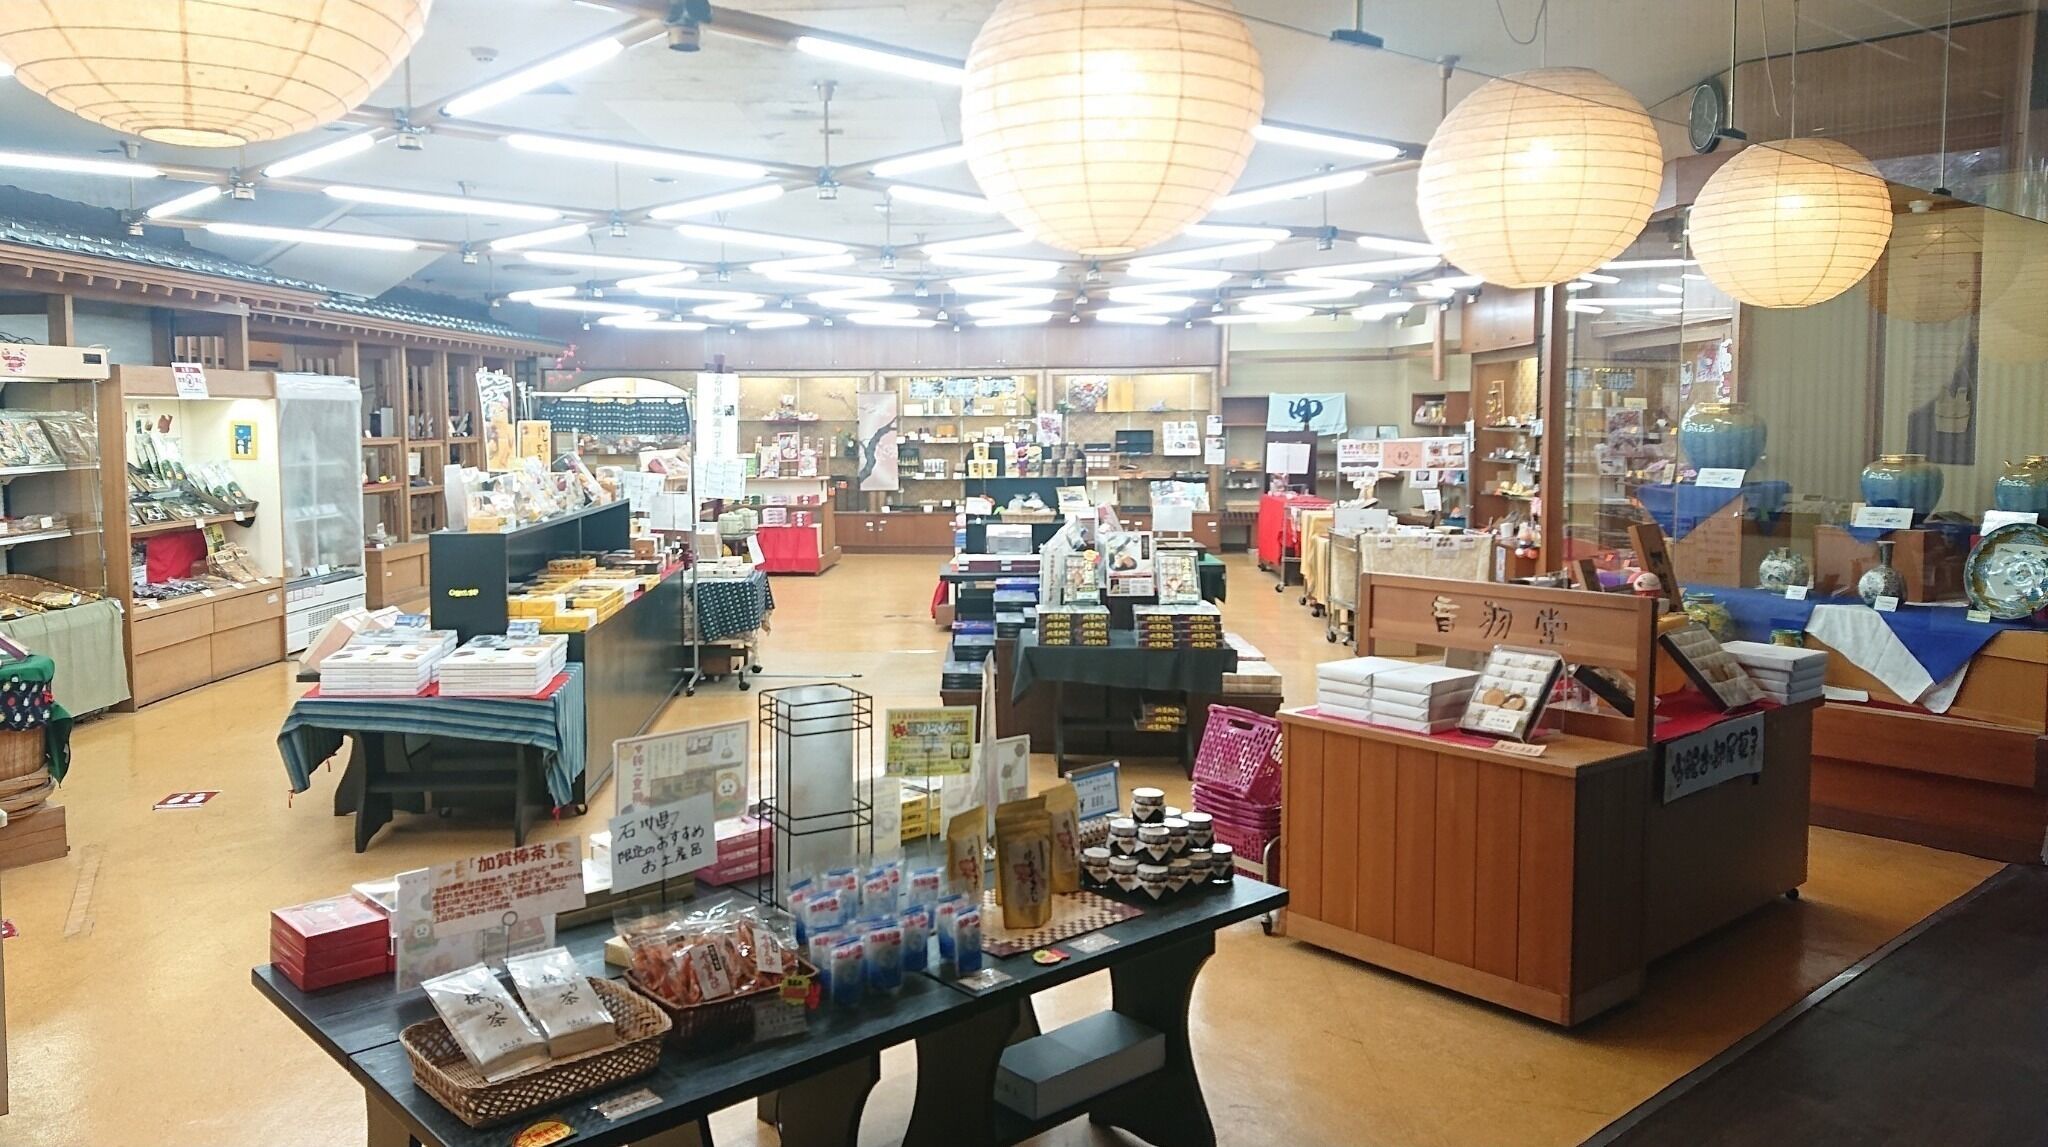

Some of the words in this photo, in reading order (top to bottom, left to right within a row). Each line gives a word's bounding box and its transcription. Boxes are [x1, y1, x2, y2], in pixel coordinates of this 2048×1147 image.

[617, 810, 669, 842] 石川県
[617, 825, 705, 865] 限定のおすすめ
